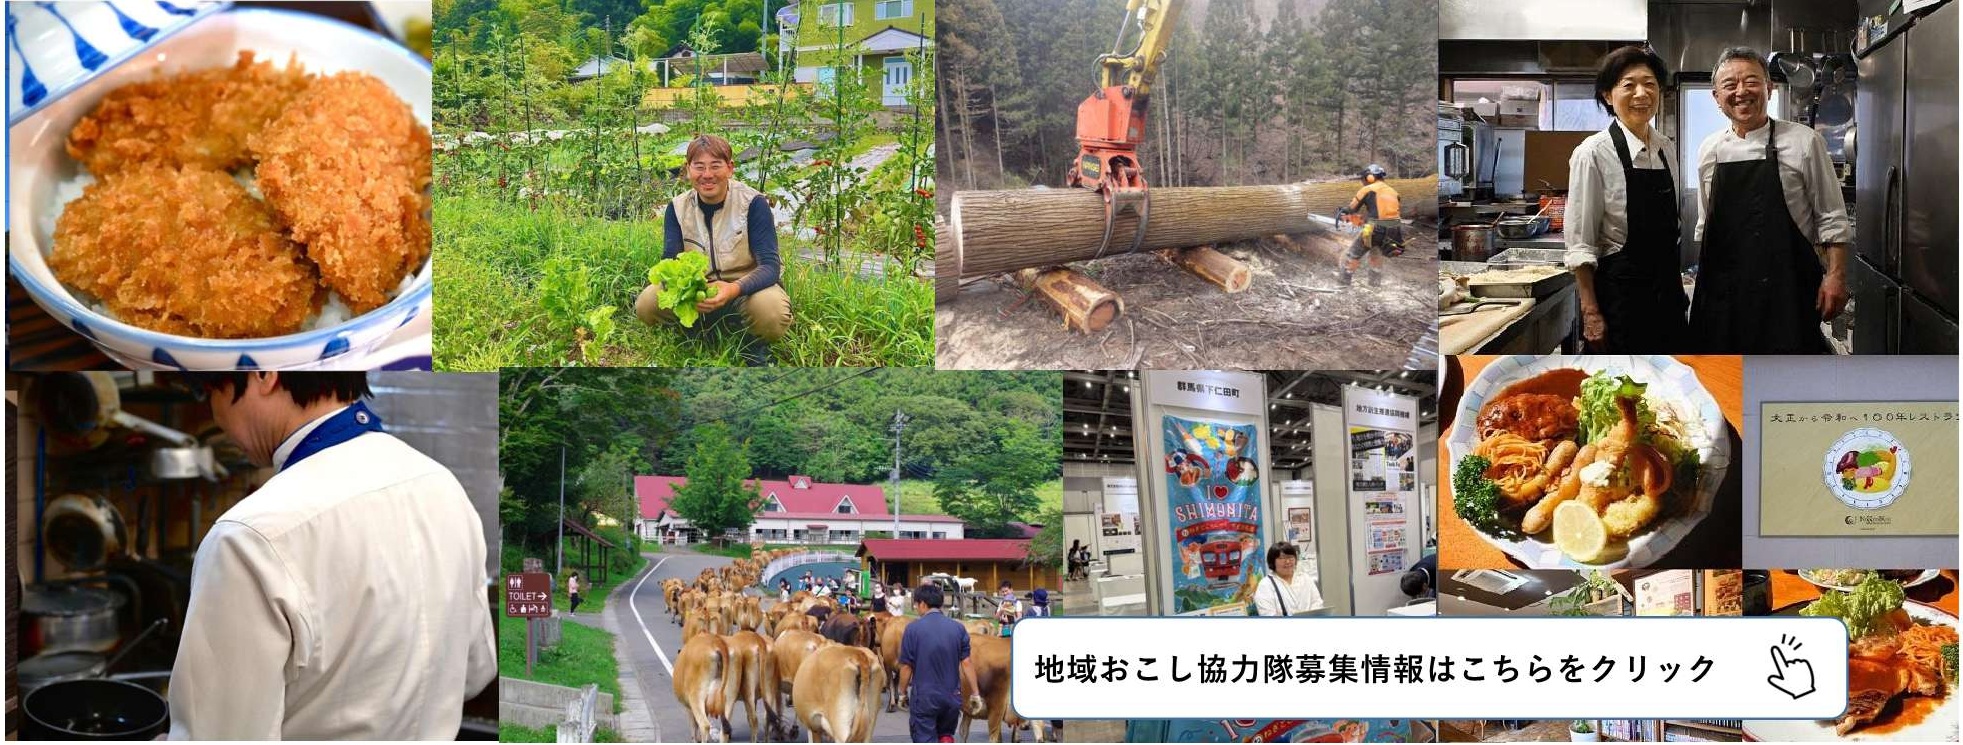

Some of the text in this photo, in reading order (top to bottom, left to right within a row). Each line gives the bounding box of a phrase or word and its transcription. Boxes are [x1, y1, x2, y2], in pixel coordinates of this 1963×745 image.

[1177, 381, 1240, 398] 群馬県下仁田町
[1175, 502, 1258, 522] SHIMONITA
[508, 592, 536, 600] TOILET
